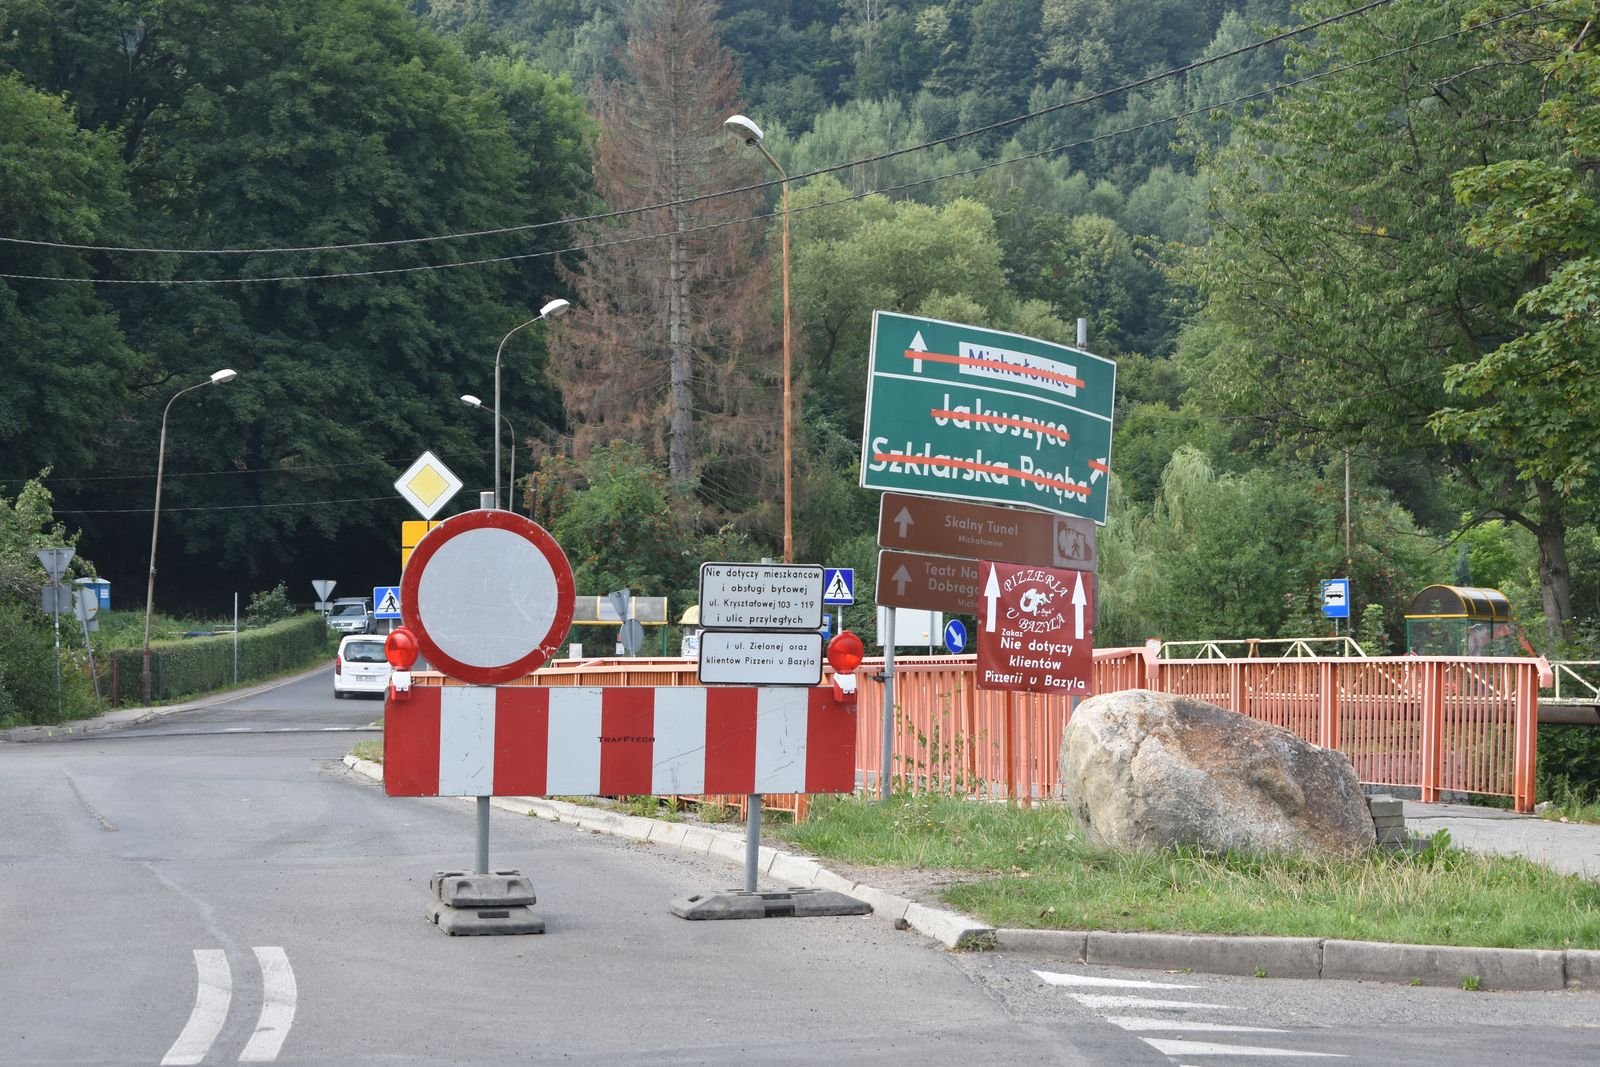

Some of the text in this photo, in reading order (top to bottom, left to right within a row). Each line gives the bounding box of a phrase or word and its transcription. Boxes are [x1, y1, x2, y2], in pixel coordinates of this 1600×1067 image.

[934, 393, 1069, 450] Jakuszyce
[869, 437, 1088, 504] Szklarska Poręba
[944, 515, 1018, 536] Skalny Tunel
[706, 568, 720, 577] Nie
[726, 568, 759, 580] dotyczy
[924, 562, 956, 577] Teatr
[722, 584, 808, 595] i obsługi bytowej
[1003, 569, 1068, 597] PIZZERIA
[723, 599, 776, 610] Kryształowej
[778, 601, 791, 609] 103
[801, 601, 815, 609] 119
[717, 614, 803, 625] i ulic przyległych
[1001, 628, 1024, 638] Zakaz
[726, 642, 729, 650] i
[734, 642, 745, 650] ul.
[749, 642, 784, 652] Zielonej
[1000, 636, 1073, 657] Nie dotyczy
[788, 657, 815, 667] Bazyla
[1009, 655, 1062, 670] klientów
[985, 670, 1086, 691] Pizzerii u Bazyla
